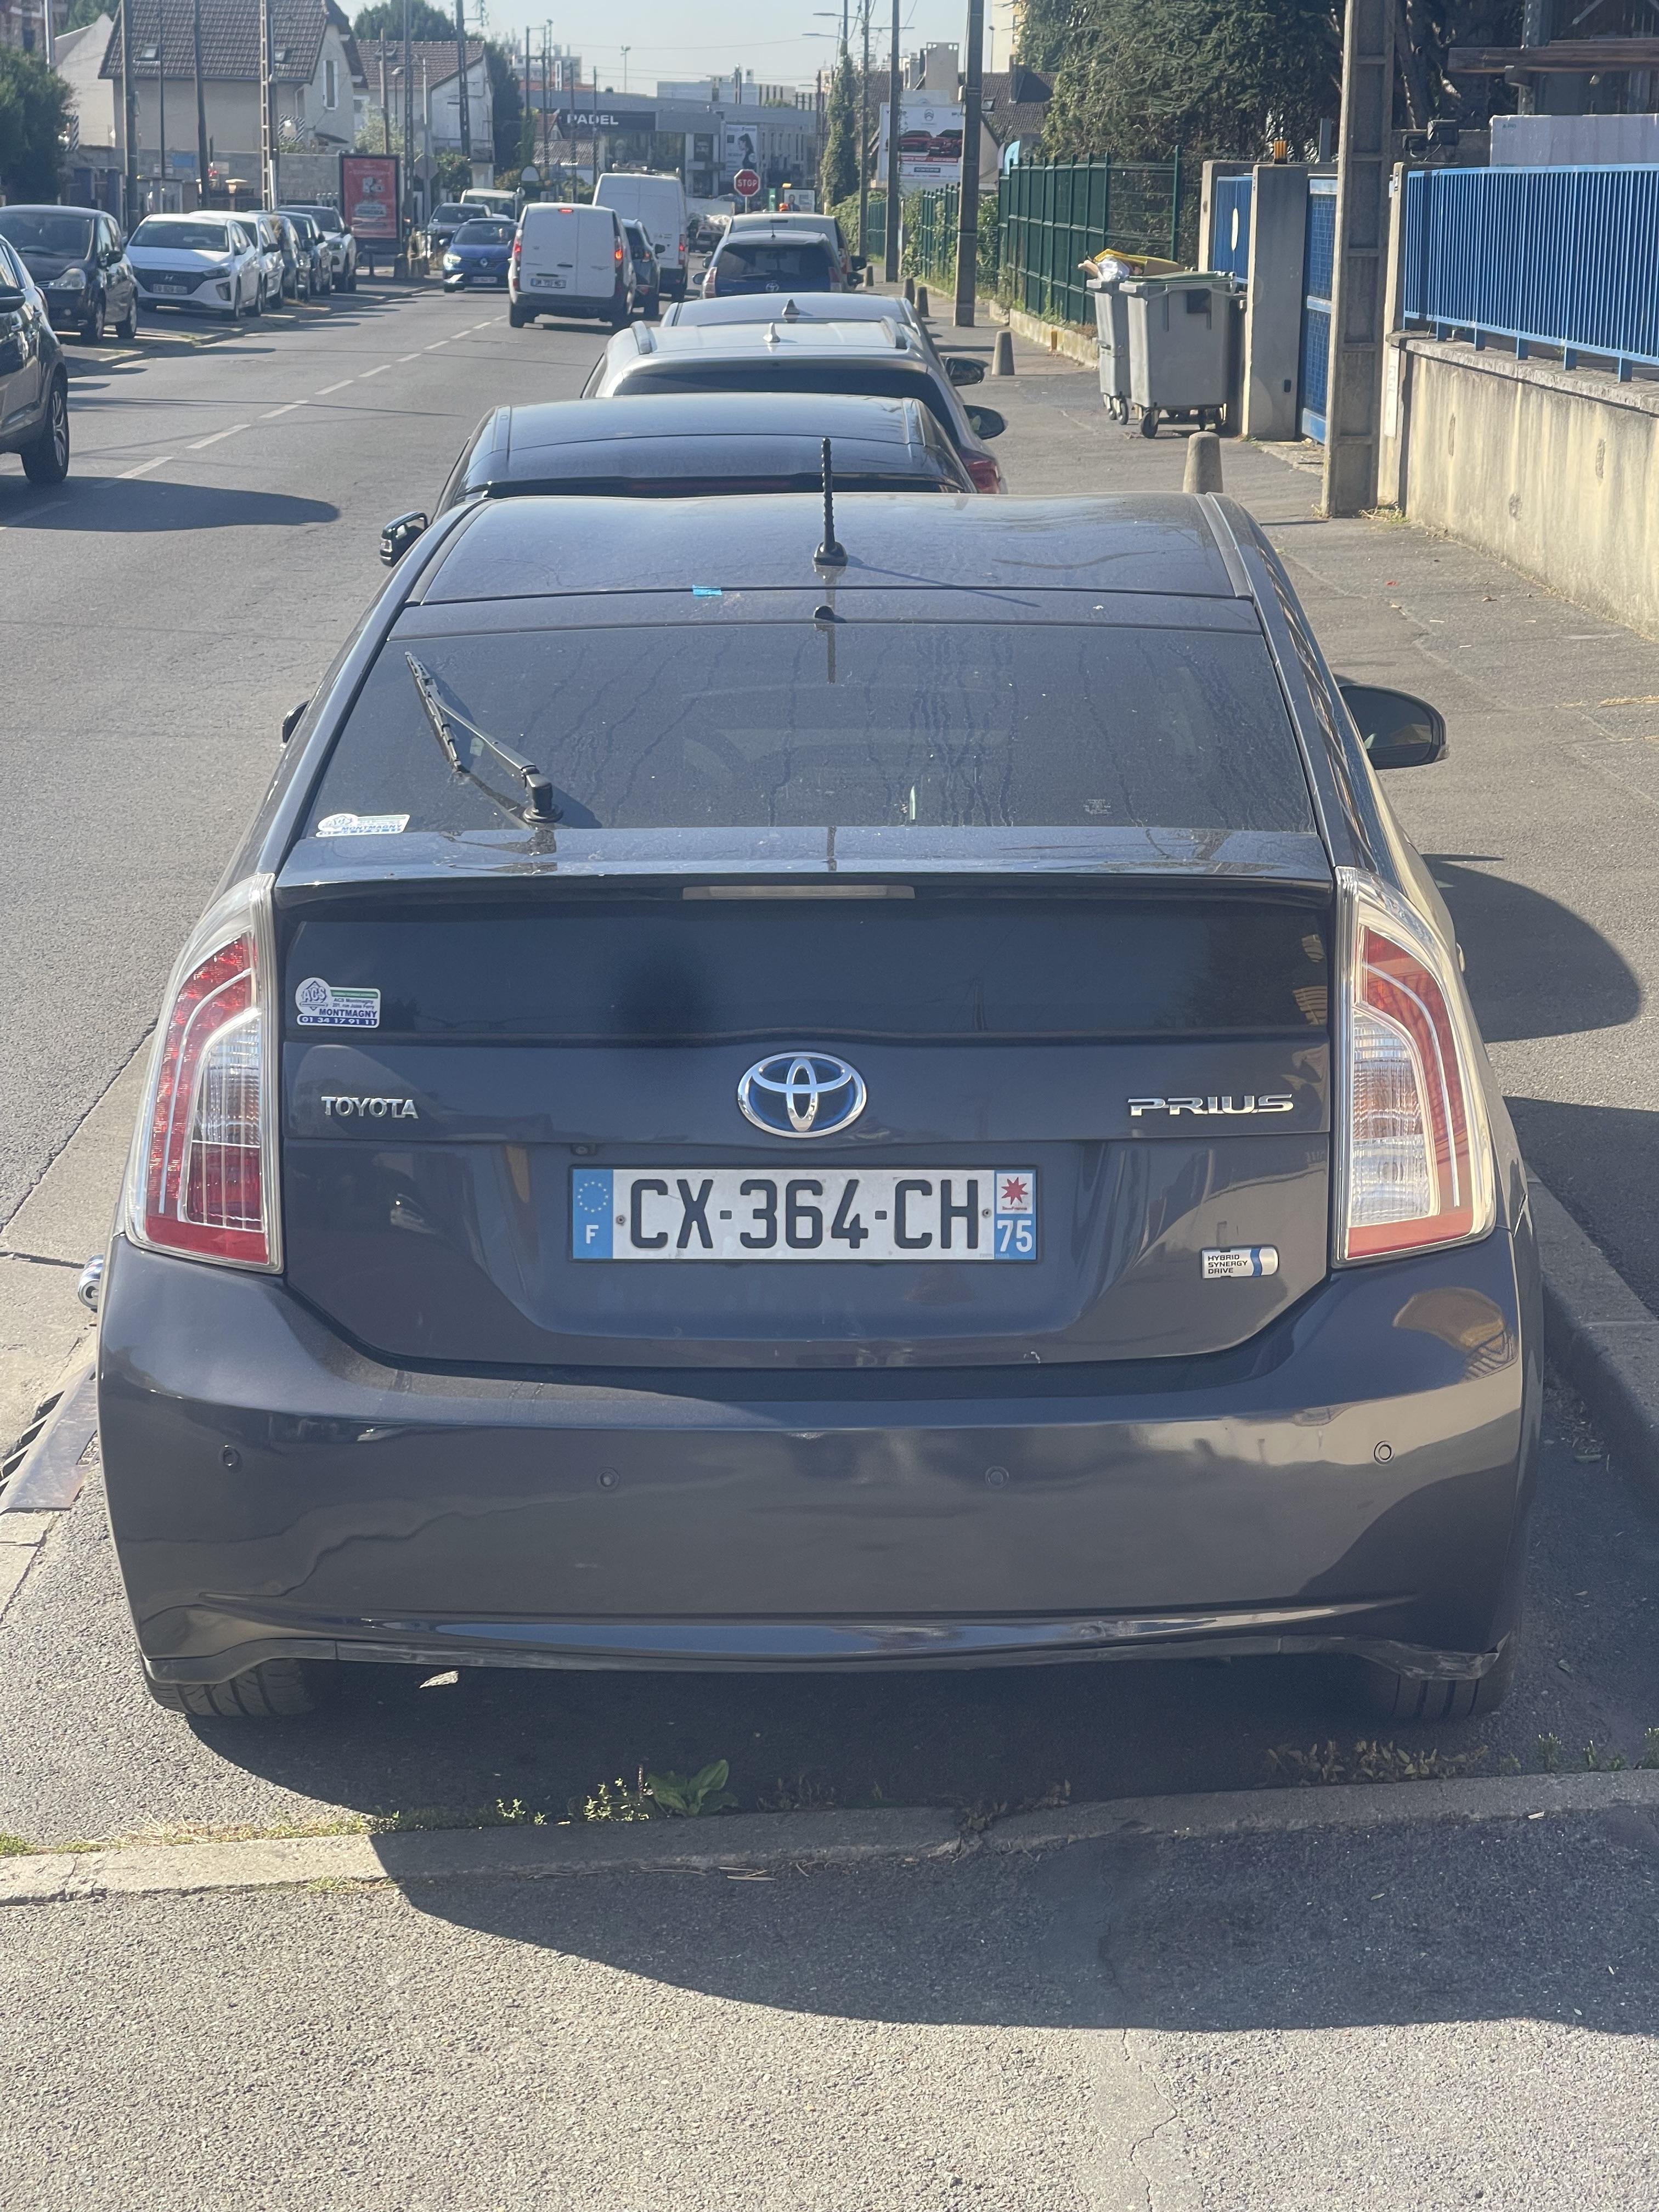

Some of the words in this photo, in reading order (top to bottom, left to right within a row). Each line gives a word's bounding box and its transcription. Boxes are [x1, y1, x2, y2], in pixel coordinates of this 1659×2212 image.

[567, 114, 619, 125] PADEL
[302, 986, 326, 1003] ACS
[319, 1008, 378, 1018] MONTMAGNY
[321, 1096, 419, 1119] TOYOTA
[1128, 1094, 1294, 1116] PRIUS
[630, 1178, 979, 1250] CX-364-CH
[586, 1224, 599, 1244] F
[997, 1220, 1032, 1252] 75
